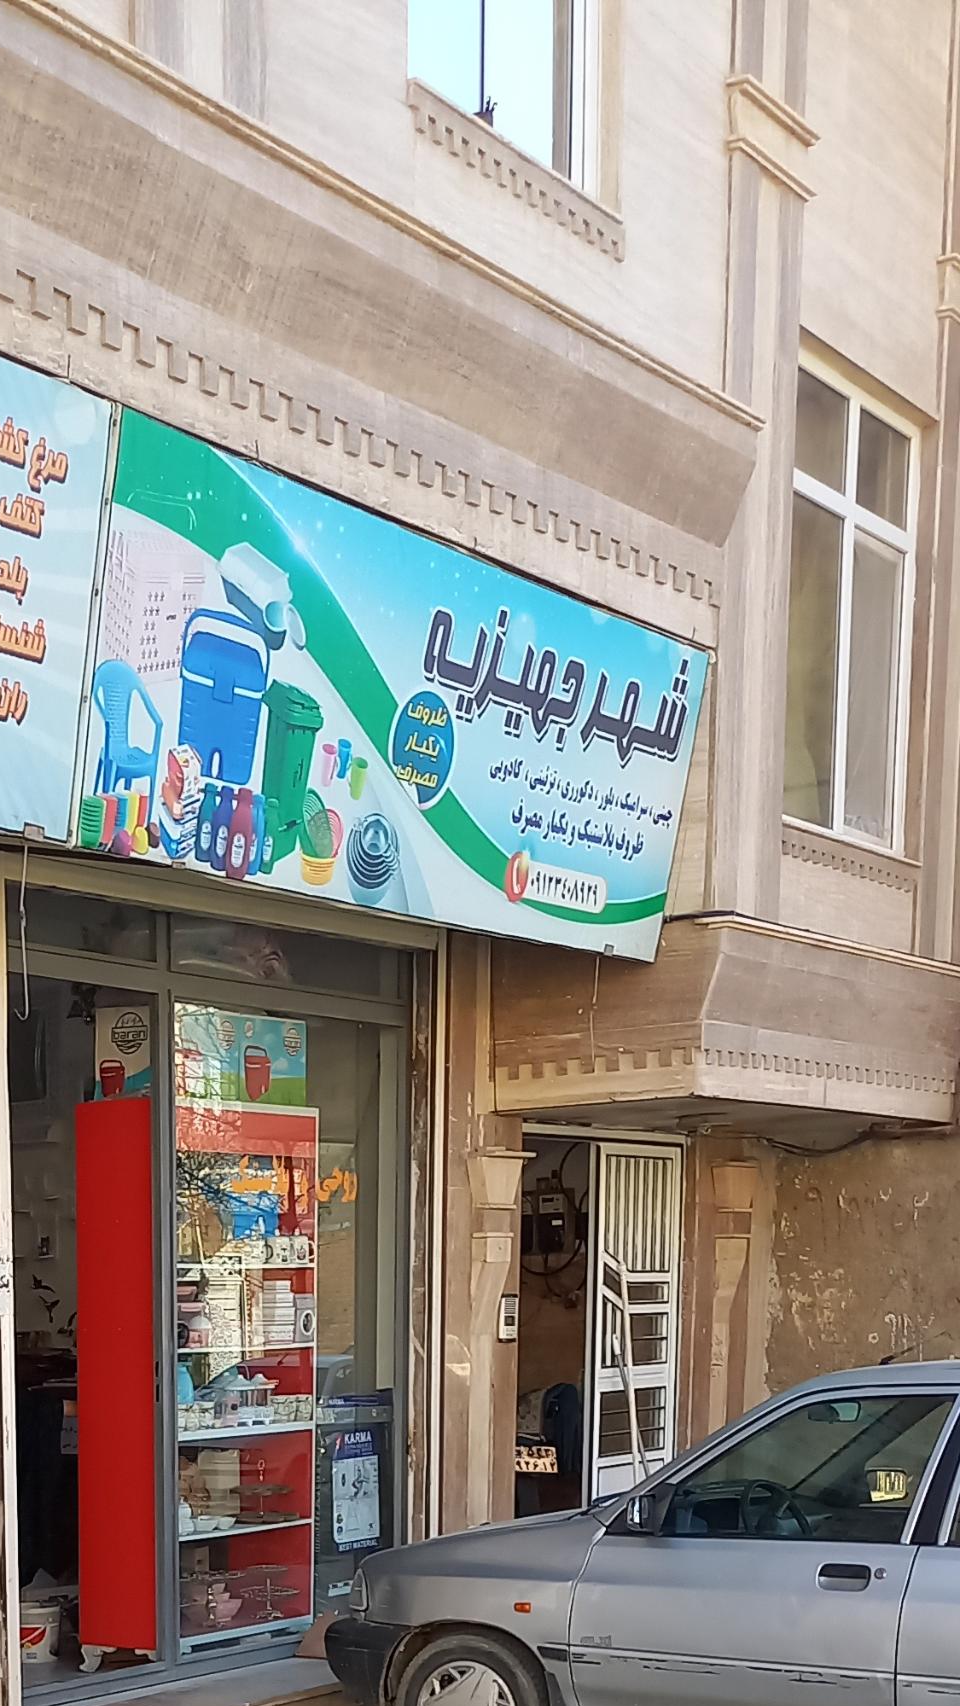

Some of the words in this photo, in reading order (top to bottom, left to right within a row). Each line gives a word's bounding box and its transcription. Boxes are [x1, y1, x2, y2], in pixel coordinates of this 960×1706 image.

[28, 437, 69, 494] مرغ
[423, 609, 586, 752] جهیزیه
[407, 701, 448, 728] ظروف
[580, 658, 689, 768] شهر
[404, 731, 440, 763] یکبار
[396, 763, 439, 789] مصرف
[512, 798, 543, 834] مصرف
[543, 809, 568, 841] یکبار
[568, 824, 576, 845] و
[578, 819, 615, 856] پلاستیک
[615, 827, 644, 860] ظروف
[344, 1431, 372, 1445] KARMA
